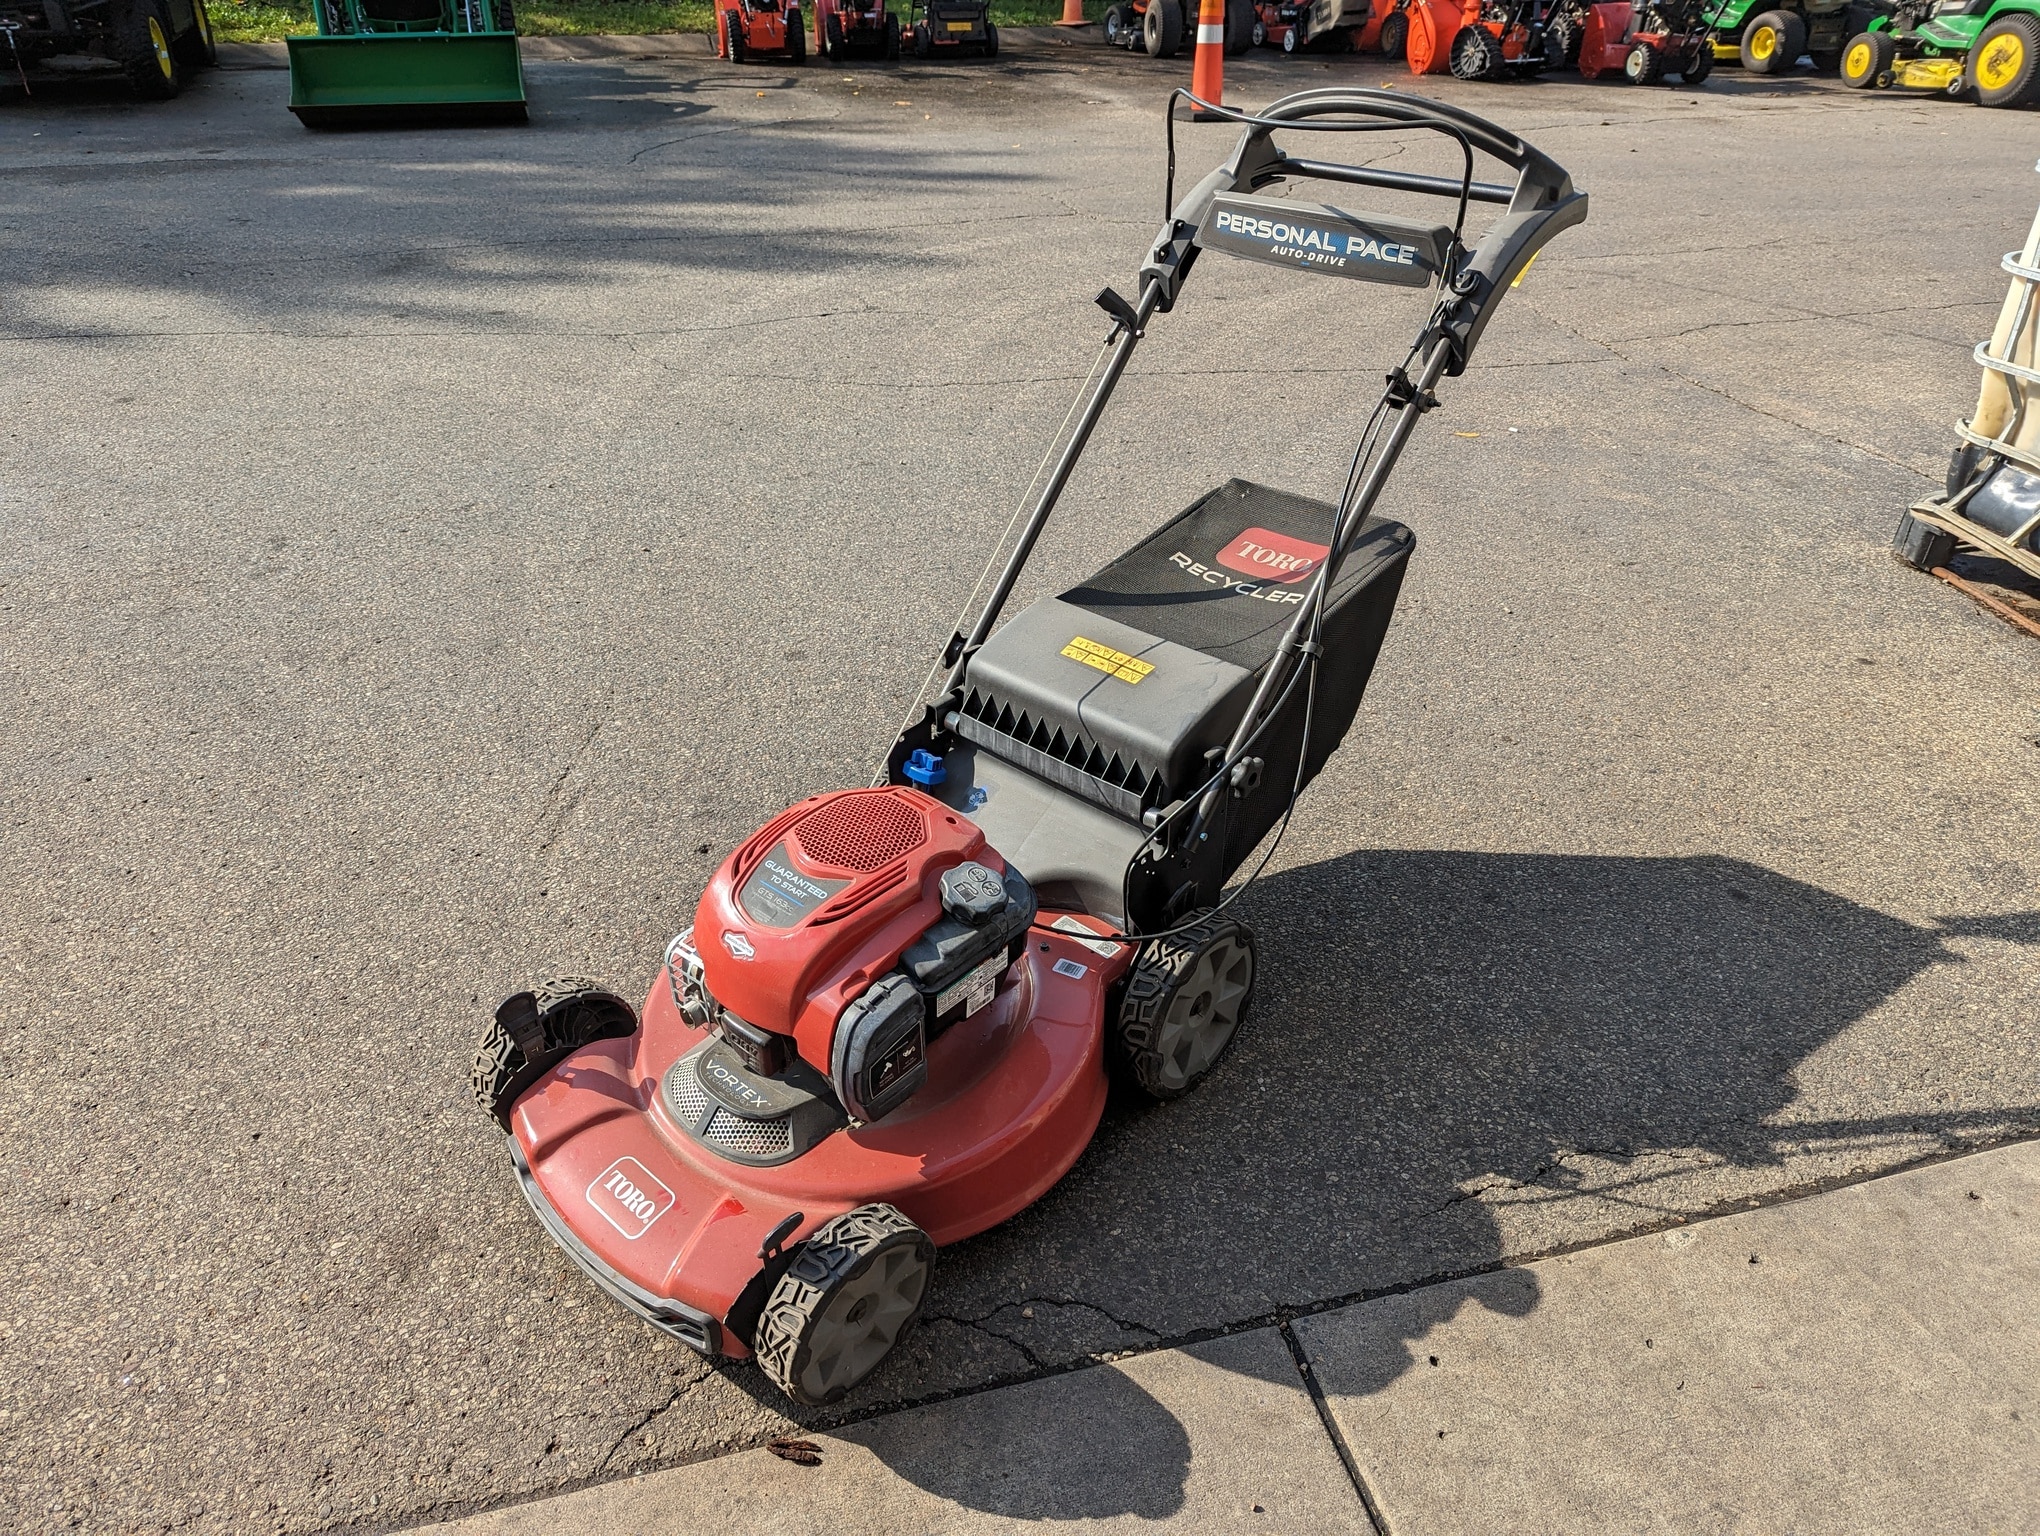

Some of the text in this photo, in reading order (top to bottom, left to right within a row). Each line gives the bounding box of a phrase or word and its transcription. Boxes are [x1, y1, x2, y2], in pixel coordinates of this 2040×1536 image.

[1216, 211, 1417, 266] PERSONAL PACE
[1270, 244, 1347, 267] AUTO-DRIVE
[1235, 541, 1313, 572] TORO
[1168, 551, 1306, 606] RECYCLER
[757, 887, 774, 900] GTS
[764, 859, 828, 899] GUARANTEED
[770, 875, 808, 899] TO START
[705, 1059, 768, 1108] VORTEX
[705, 1072, 751, 1107] TECHNOLOGY
[603, 1169, 656, 1220] TORO
